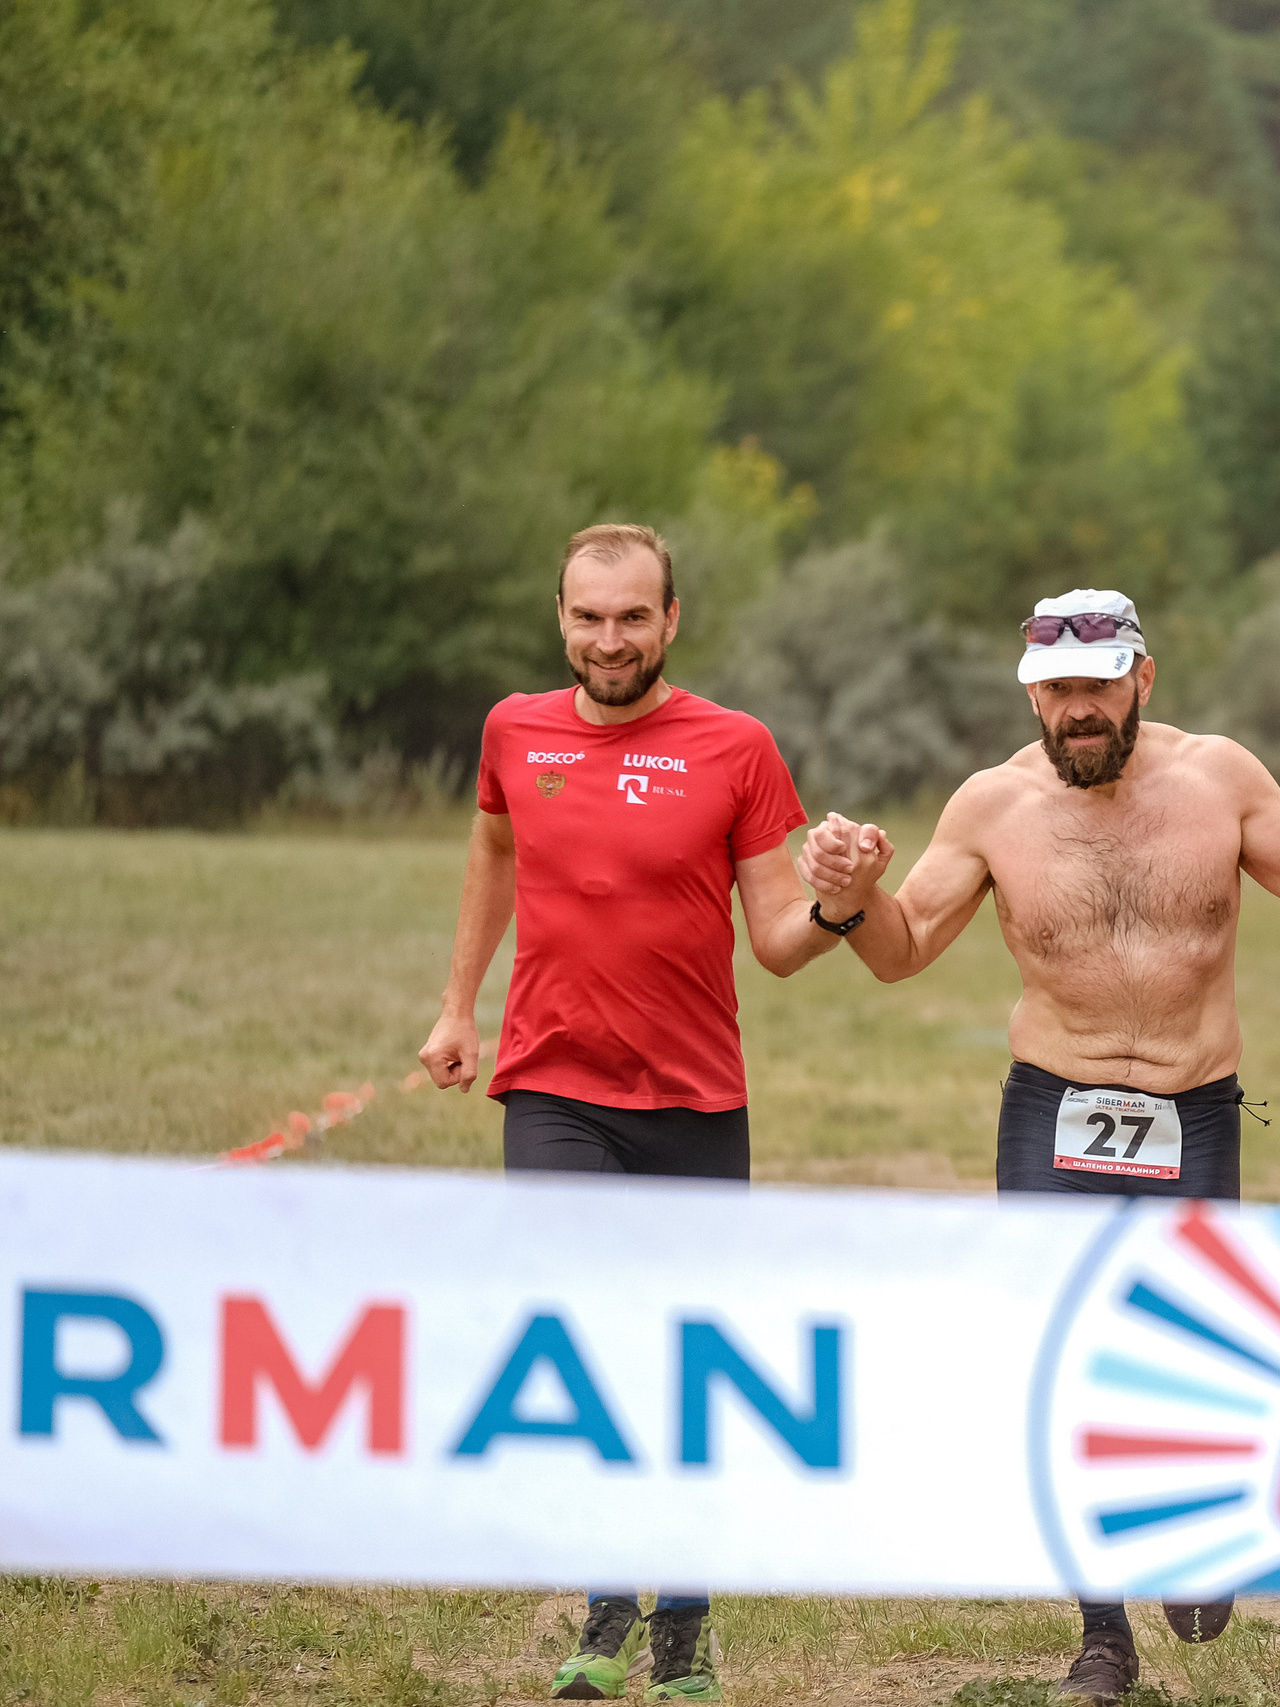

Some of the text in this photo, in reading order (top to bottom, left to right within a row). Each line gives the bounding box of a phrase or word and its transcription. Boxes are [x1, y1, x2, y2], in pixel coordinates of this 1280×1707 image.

[527, 751, 576, 764] BOSCO
[623, 753, 688, 773] LUKOIL
[652, 785, 686, 798] RUSAL
[1096, 1097, 1145, 1108] SIBERMAN
[1083, 1112, 1155, 1159] 27
[1073, 1160, 1160, 1175] ШАПЕНКО ВЛАДИМИР
[16, 1283, 848, 1471] RMAN
